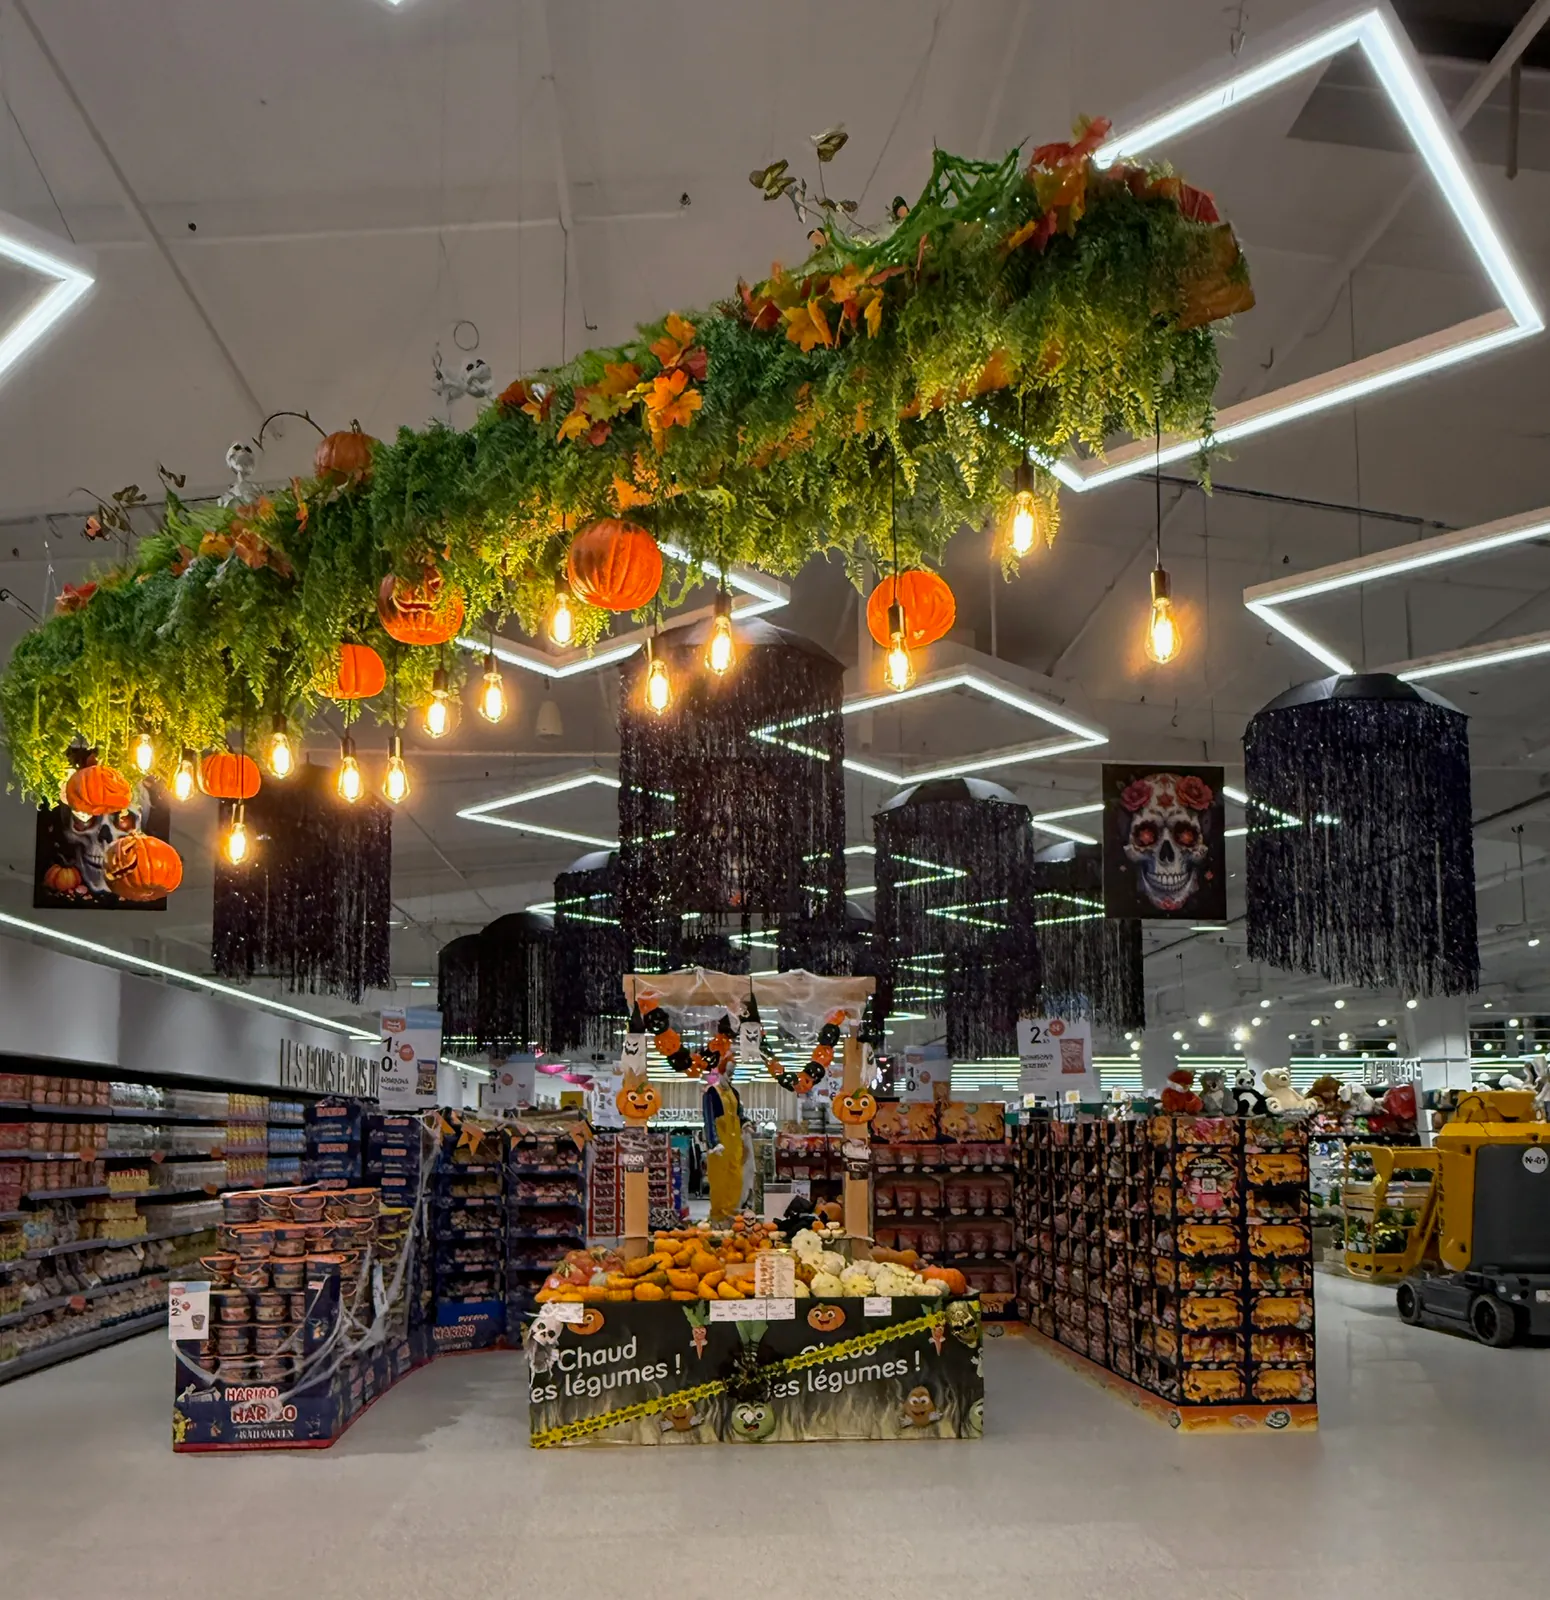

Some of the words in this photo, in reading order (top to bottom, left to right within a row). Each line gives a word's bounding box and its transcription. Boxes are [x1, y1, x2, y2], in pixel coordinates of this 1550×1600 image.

[381, 1036, 393, 1053] 1
[1030, 1026, 1041, 1044] 2
[381, 1055, 393, 1072] 0
[558, 1335, 637, 1371] Chaud
[565, 1362, 668, 1397] légumes
[675, 1353, 681, 1375] !
[807, 1358, 908, 1393] légumes
[914, 1350, 921, 1372] !
